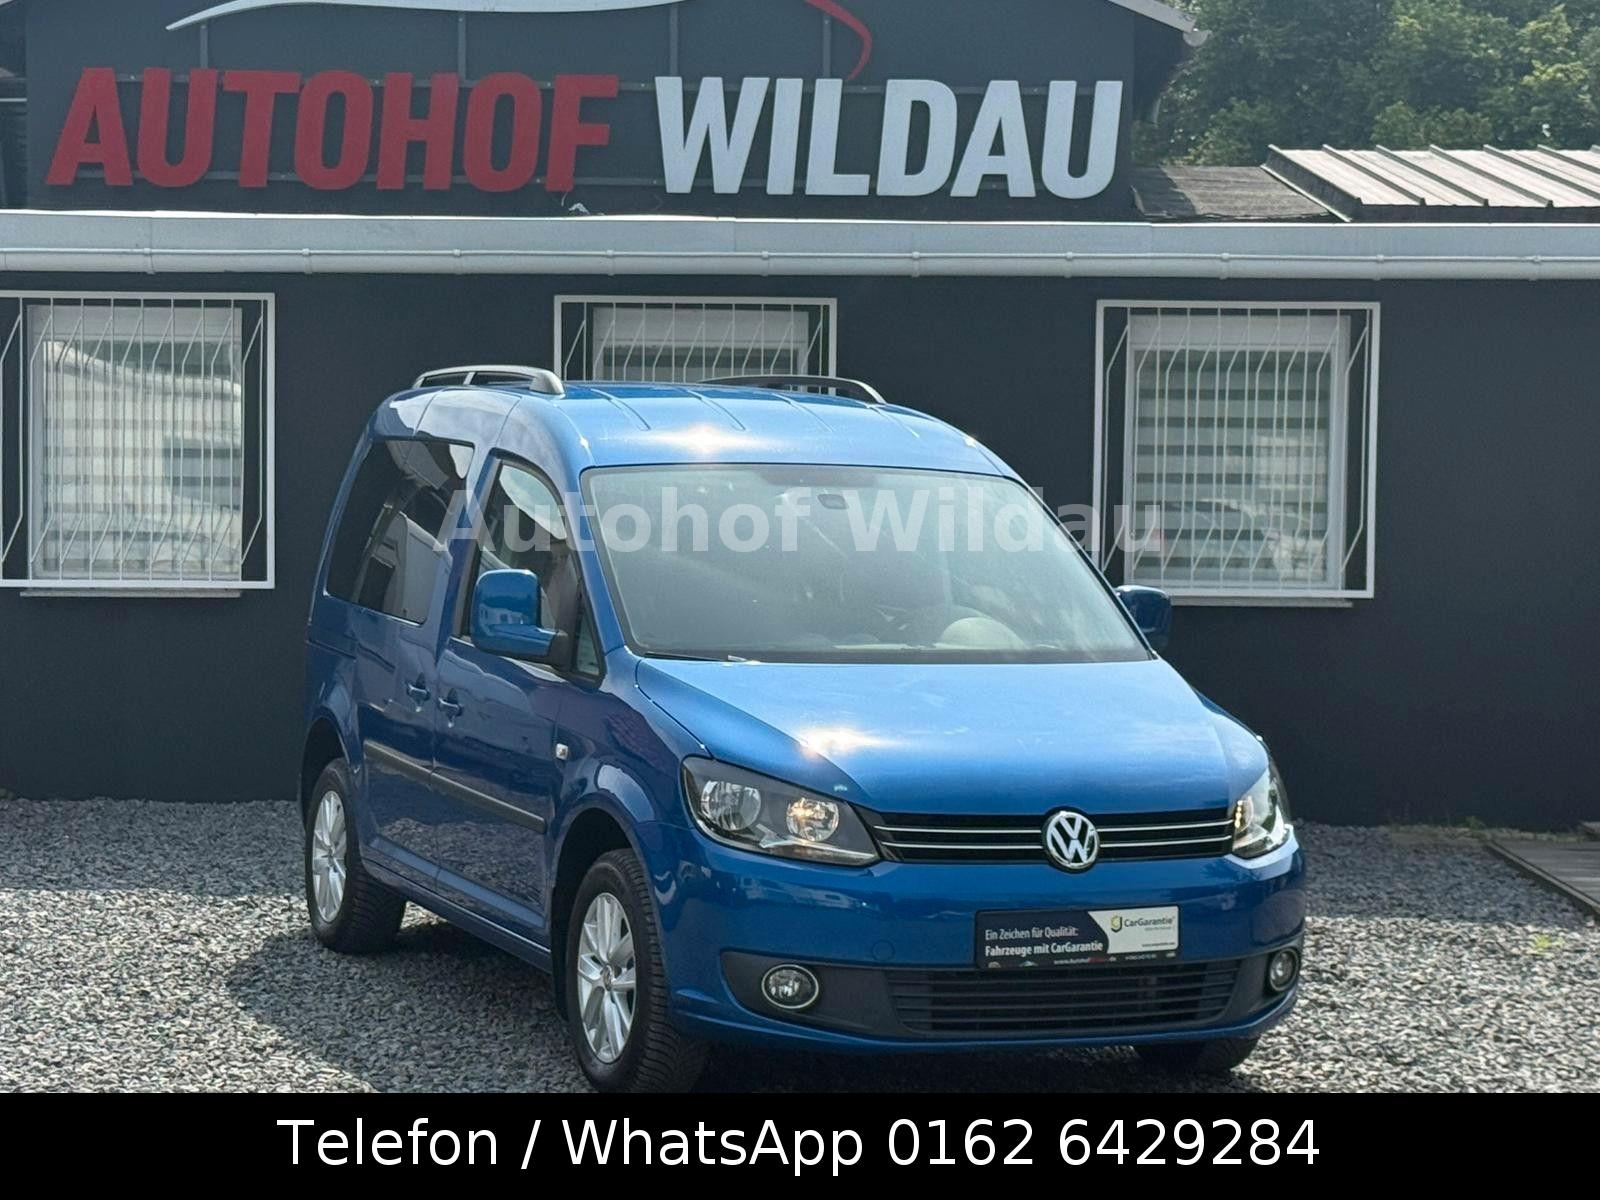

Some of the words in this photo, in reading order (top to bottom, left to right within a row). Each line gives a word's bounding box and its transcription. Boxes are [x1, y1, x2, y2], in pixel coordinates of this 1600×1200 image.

[47, 67, 620, 193] AUTOHOF
[652, 75, 1124, 199] WILDAU
[1124, 916, 1173, 927] CarGarantie
[985, 929, 998, 941] Ein
[999, 928, 1031, 940] Zeichen
[1032, 927, 1043, 938] für
[985, 945, 1033, 958] Fahrzeuge
[1033, 944, 1050, 954] mit
[1051, 940, 1104, 954] CarGarantie
